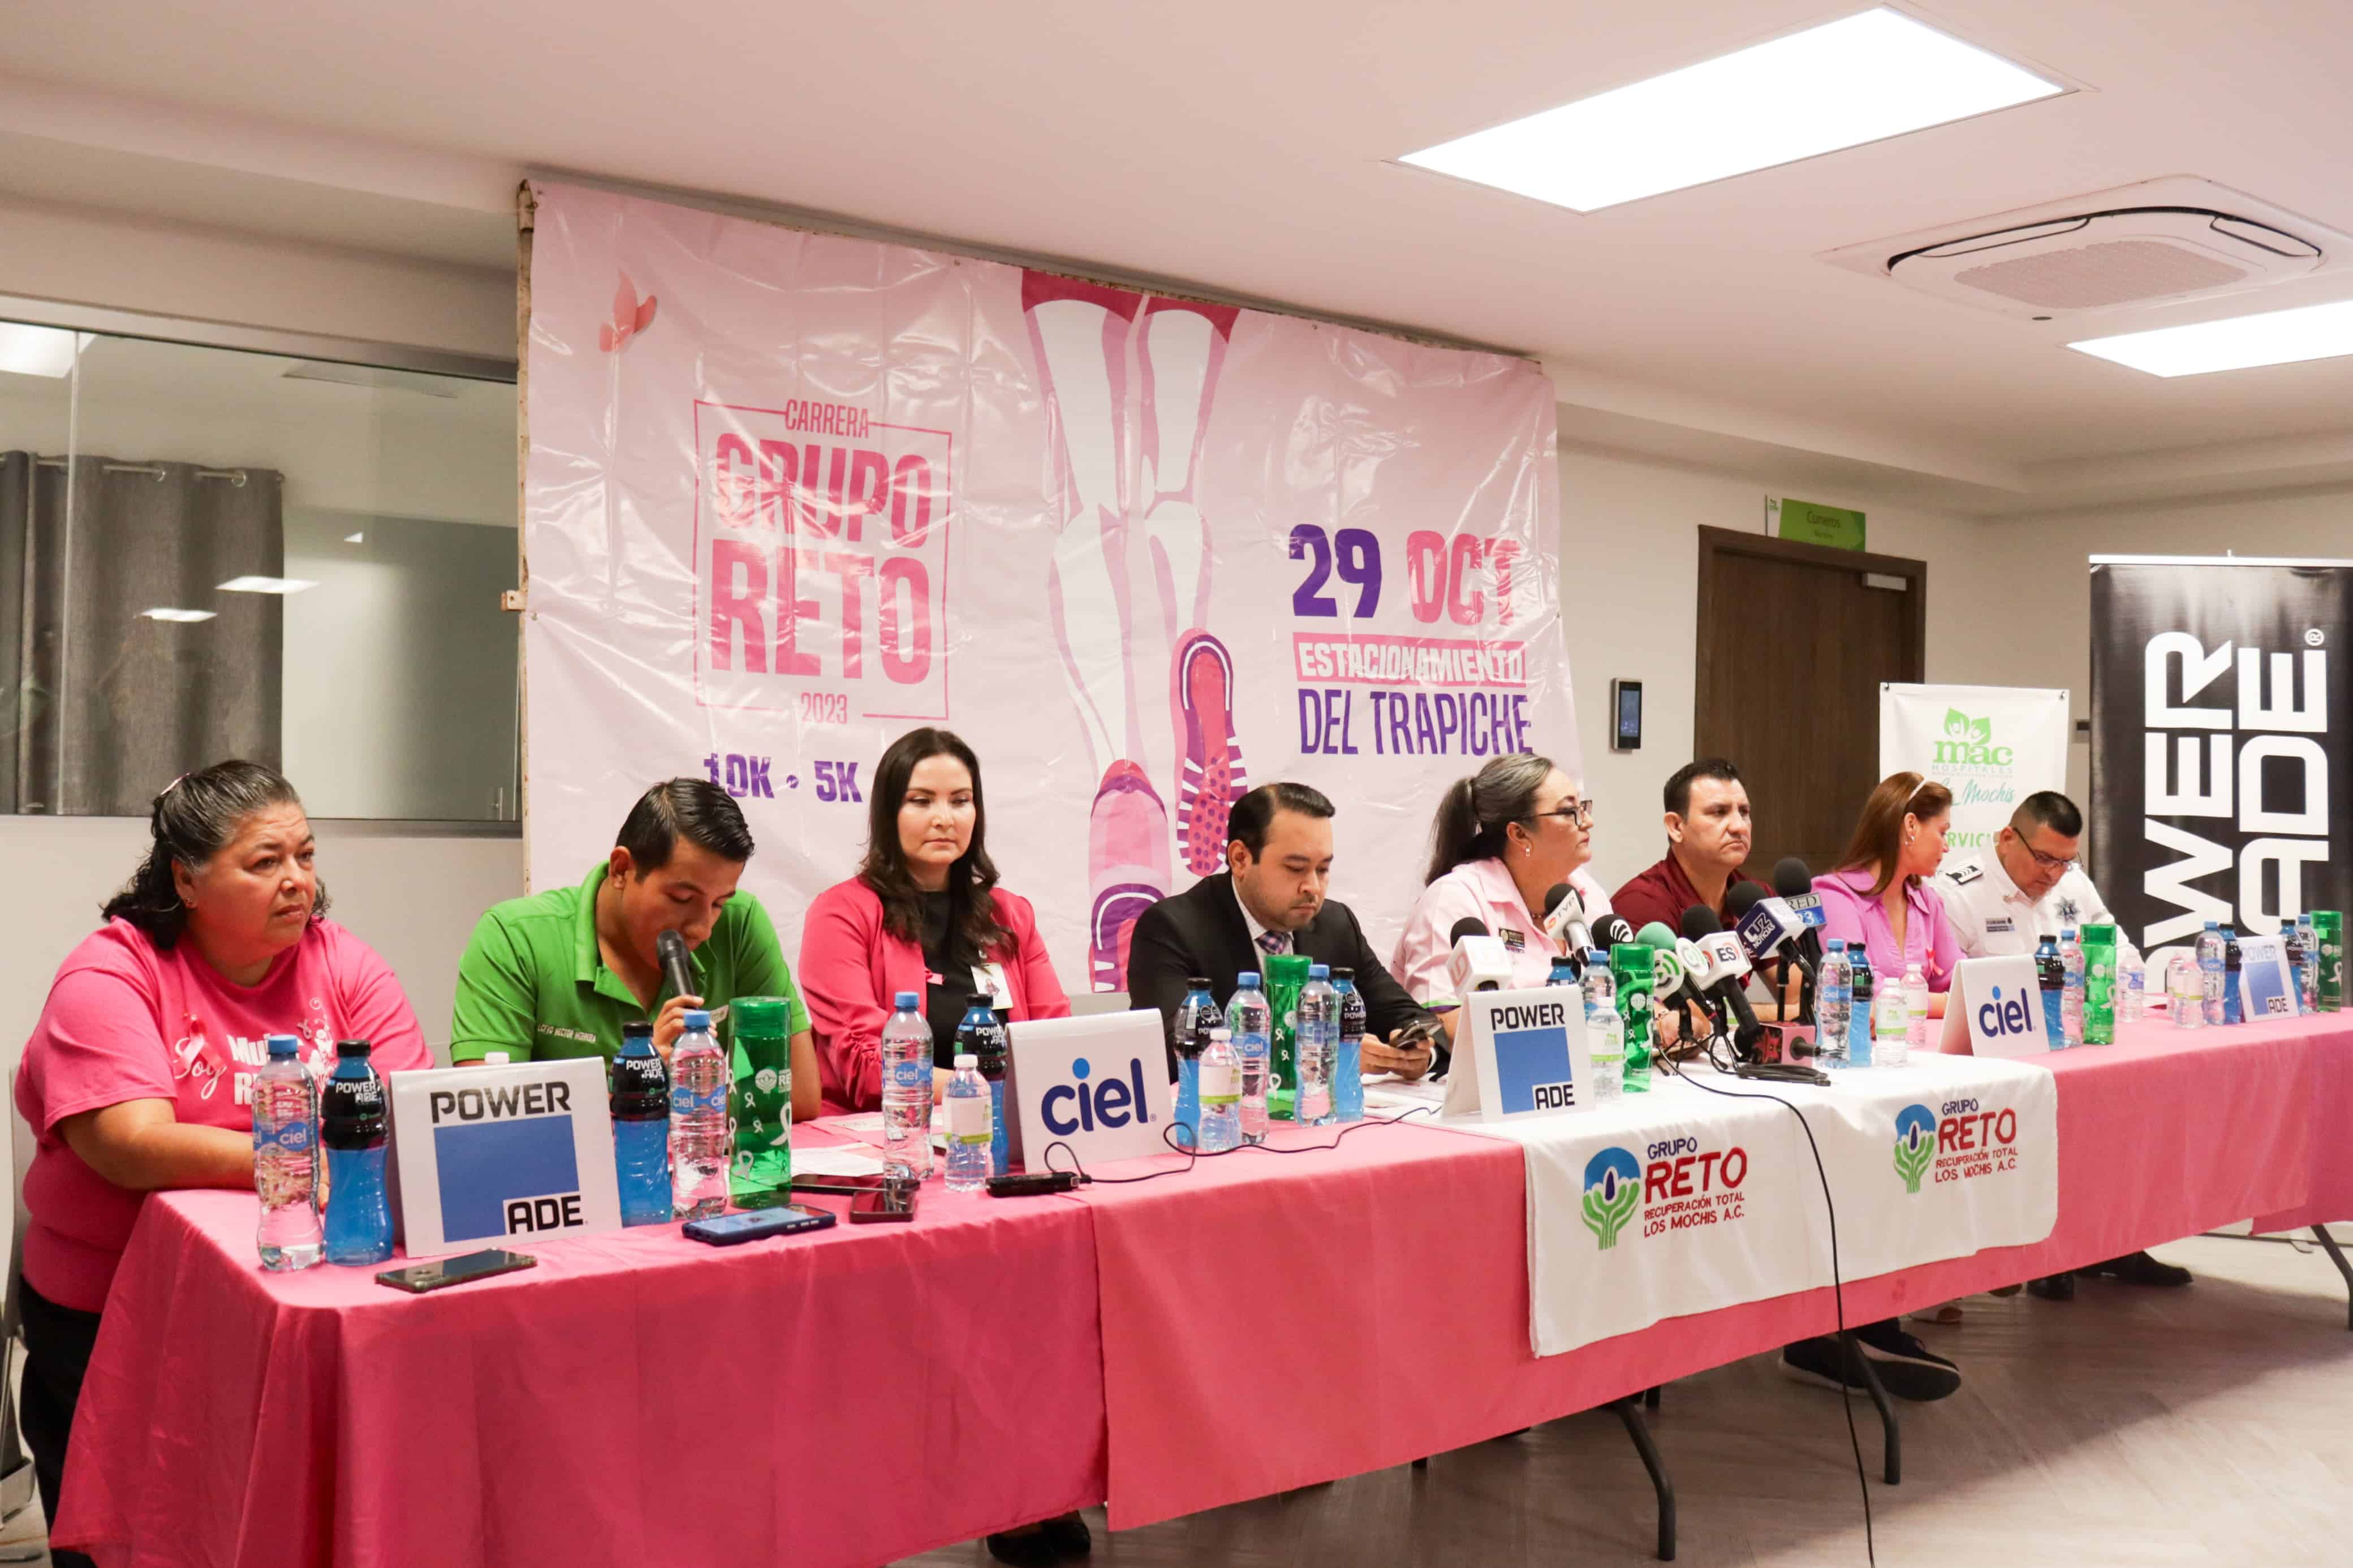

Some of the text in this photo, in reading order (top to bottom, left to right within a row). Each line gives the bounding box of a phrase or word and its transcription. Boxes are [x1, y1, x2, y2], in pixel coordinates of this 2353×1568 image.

[785, 399, 869, 439] CARRERA
[714, 433, 932, 549] GRUPO
[1289, 524, 1521, 626] 29 OCT
[711, 539, 932, 684] RETO
[1299, 642, 1522, 682] ESTACIONAMIENTO
[801, 692, 847, 725] 2023
[1298, 688, 1533, 756] DEL TRAPICHE
[1933, 740, 2013, 765] mac
[704, 752, 863, 803] 10K 5K
[1932, 764, 2013, 774] HOSPITALES
[1946, 833, 1990, 847] RVIC
[1743, 912, 1772, 943] LUZ
[1716, 946, 1737, 963] ES
[1490, 1003, 1566, 1031] POWER
[1979, 985, 2032, 1037] ciel
[2268, 997, 2290, 1014] ADE
[1245, 1041, 1264, 1052] ciel
[626, 1059, 662, 1071] POWER
[895, 1068, 919, 1081] ciel
[336, 1081, 376, 1094] POWER
[673, 1095, 726, 1108] ciel cie
[1535, 1084, 1575, 1110] ADE
[430, 1081, 571, 1124] POWER
[1942, 1098, 1979, 1115] GRUPO
[279, 1128, 307, 1144] ciel
[1938, 1108, 2016, 1154] RETO
[1648, 1136, 1697, 1160] GRUPO
[1993, 1147, 2018, 1158] TOTAL
[1645, 1147, 1747, 1204] RETO
[1935, 1169, 1958, 1183] LOS
[1964, 1163, 1992, 1178] MOCHIS
[507, 1195, 584, 1235] ADE
[1644, 1192, 1744, 1221] RECUPERACIÓN TOTAL
[1644, 1205, 1744, 1237] LOS MOCHIS A.C.
